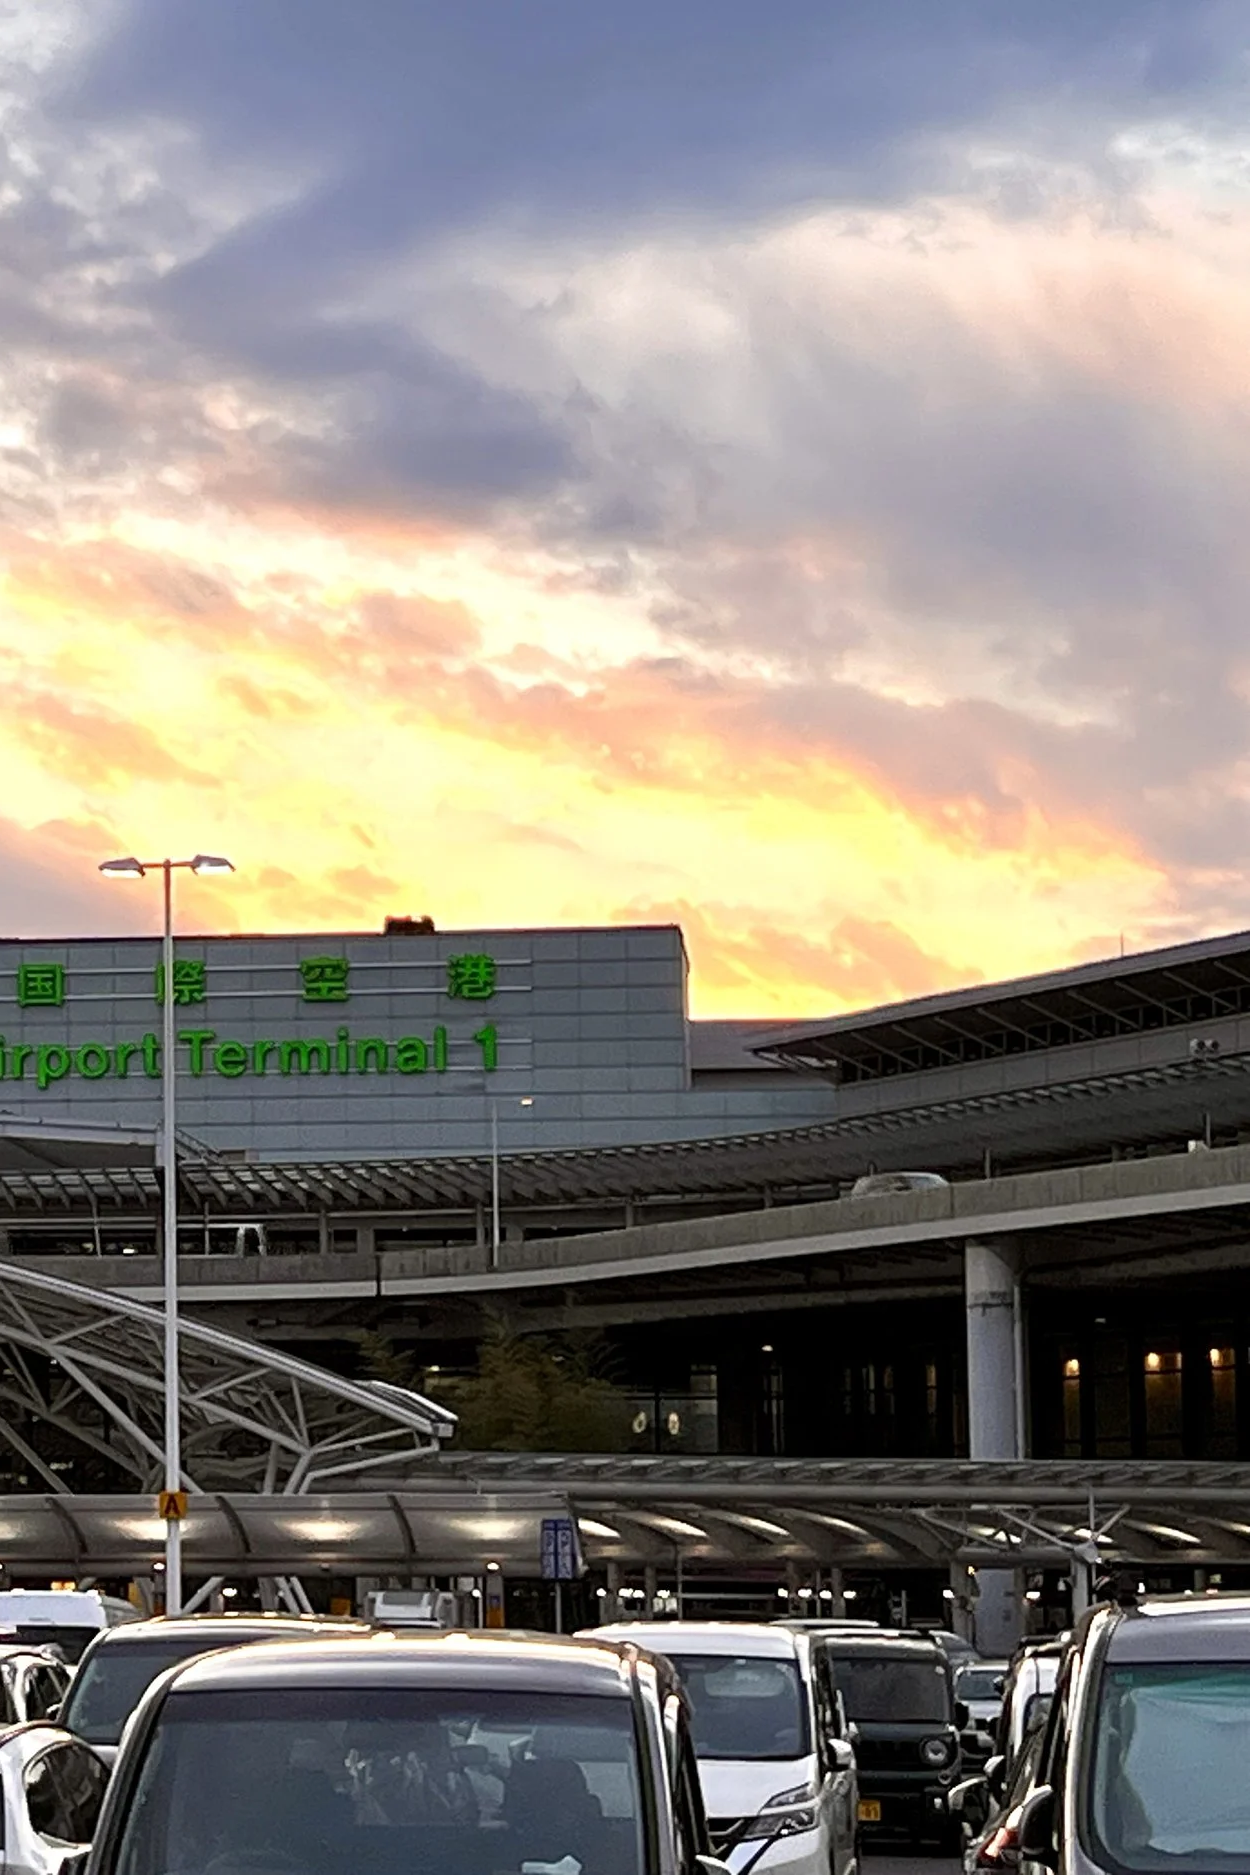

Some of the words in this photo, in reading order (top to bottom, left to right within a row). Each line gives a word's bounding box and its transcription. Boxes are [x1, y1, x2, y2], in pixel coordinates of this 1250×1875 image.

[176, 1025, 449, 1078] Terminal
[472, 1021, 499, 1074] 1
[164, 1493, 181, 1515] A
